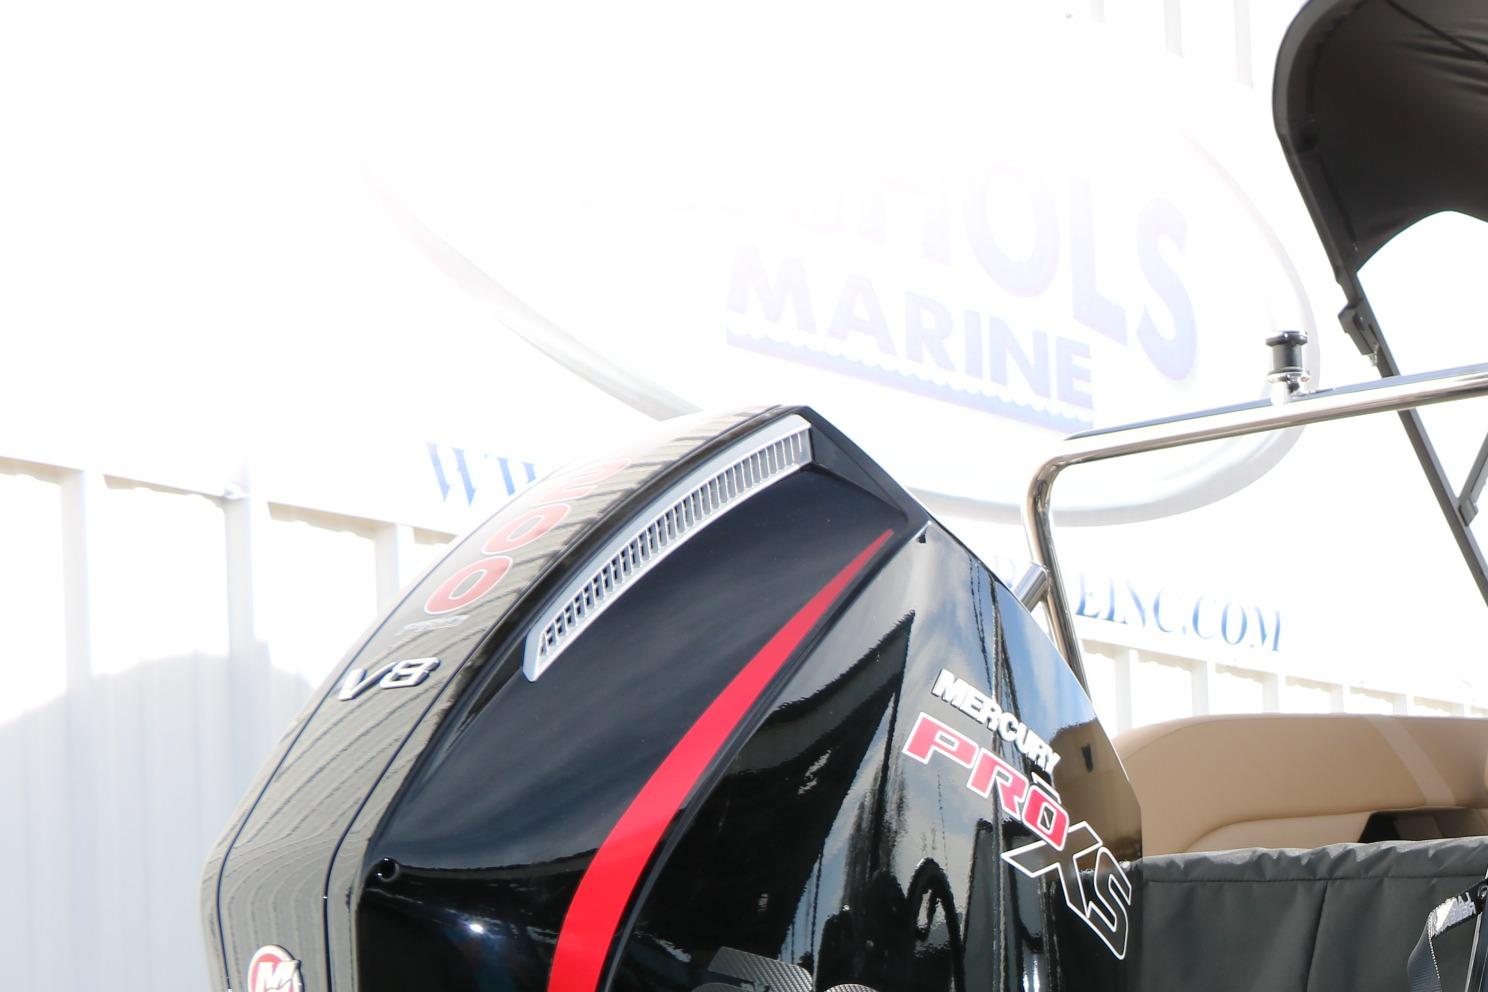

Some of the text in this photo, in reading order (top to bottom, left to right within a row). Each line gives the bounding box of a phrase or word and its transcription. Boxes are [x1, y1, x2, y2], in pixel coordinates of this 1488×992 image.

[725, 242, 1095, 415] MARINE
[338, 657, 441, 702] V8
[931, 669, 1062, 771] MERCURY
[902, 712, 1132, 960] PRO XS
